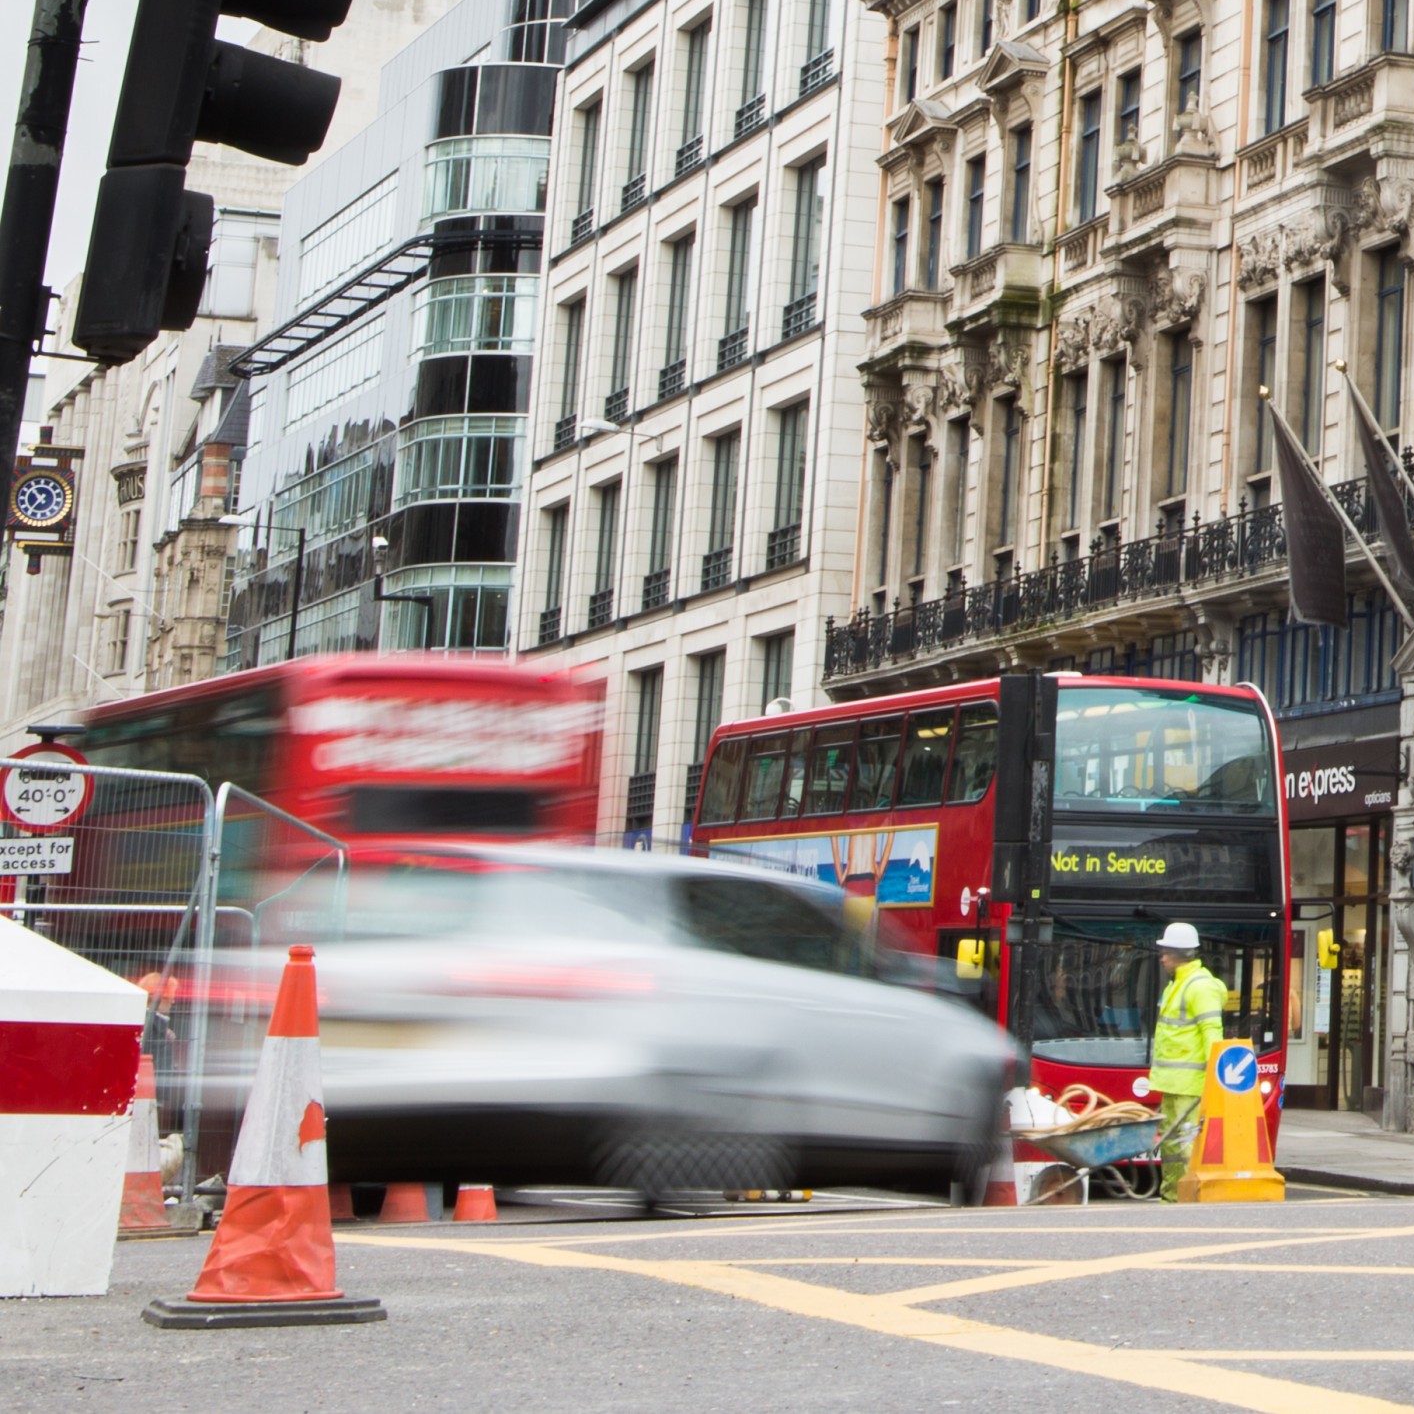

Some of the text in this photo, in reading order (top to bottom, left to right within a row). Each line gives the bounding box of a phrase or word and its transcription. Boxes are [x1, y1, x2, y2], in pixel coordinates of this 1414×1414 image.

[1298, 764, 1356, 804] express
[1364, 790, 1392, 807] opticians
[50, 842, 71, 854] for
[3, 859, 56, 869] access
[1051, 851, 1166, 874] Not in Service
